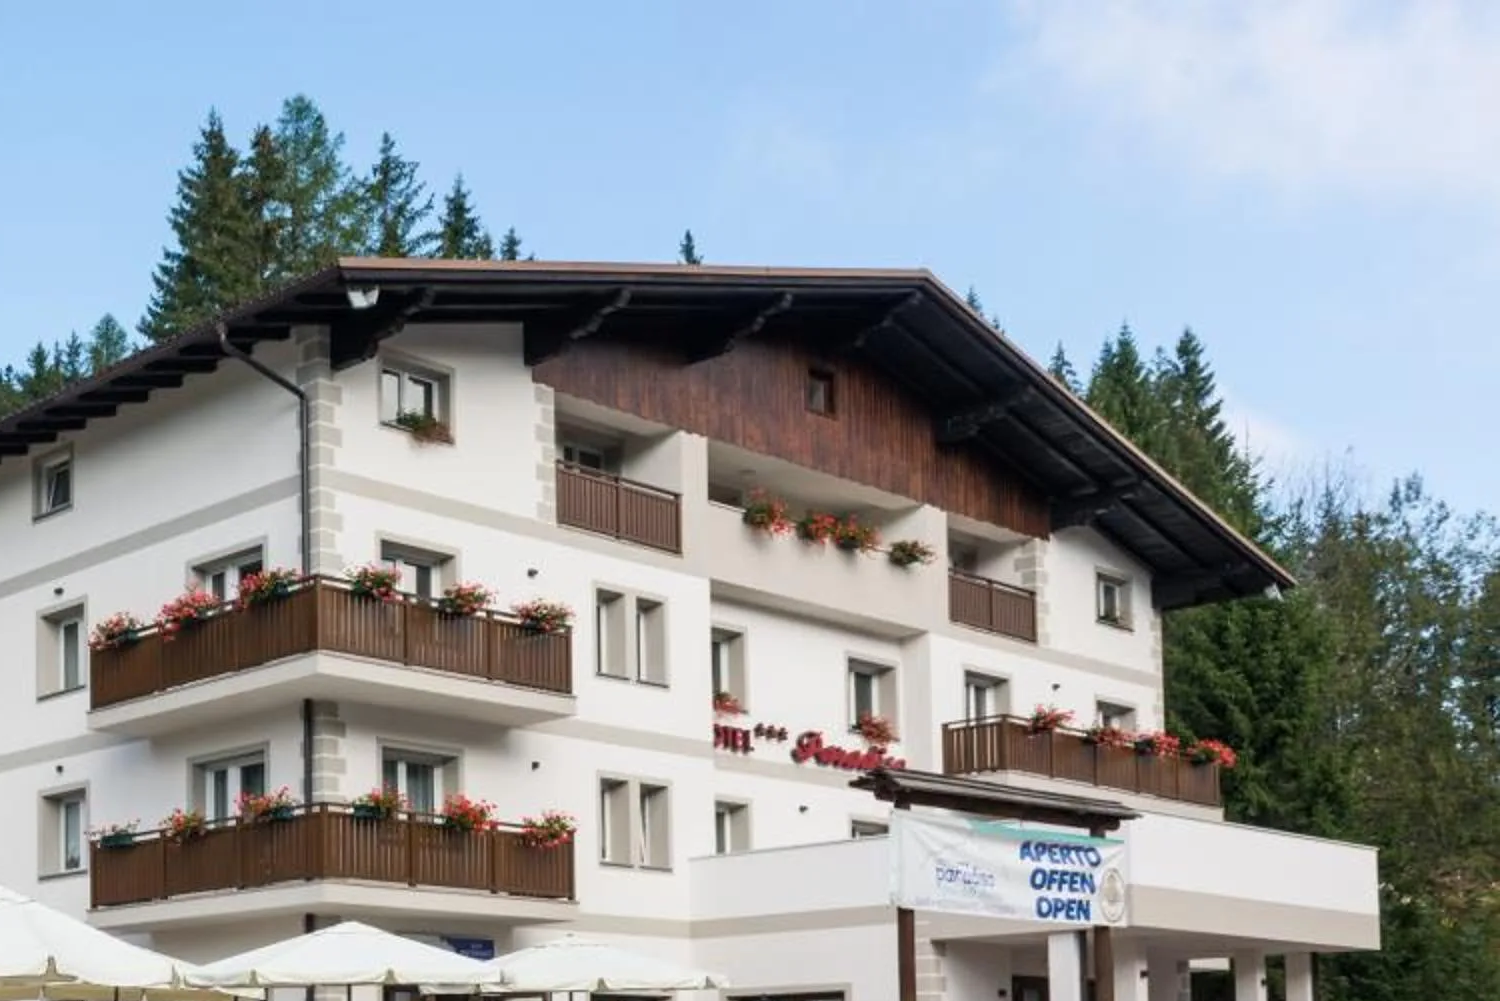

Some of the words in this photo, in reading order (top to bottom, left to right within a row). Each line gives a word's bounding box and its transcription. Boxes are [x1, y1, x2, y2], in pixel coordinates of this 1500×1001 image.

[1019, 840, 1102, 868] APERTO
[1030, 867, 1096, 894] OFFEN
[1036, 896, 1091, 922] OPEN
